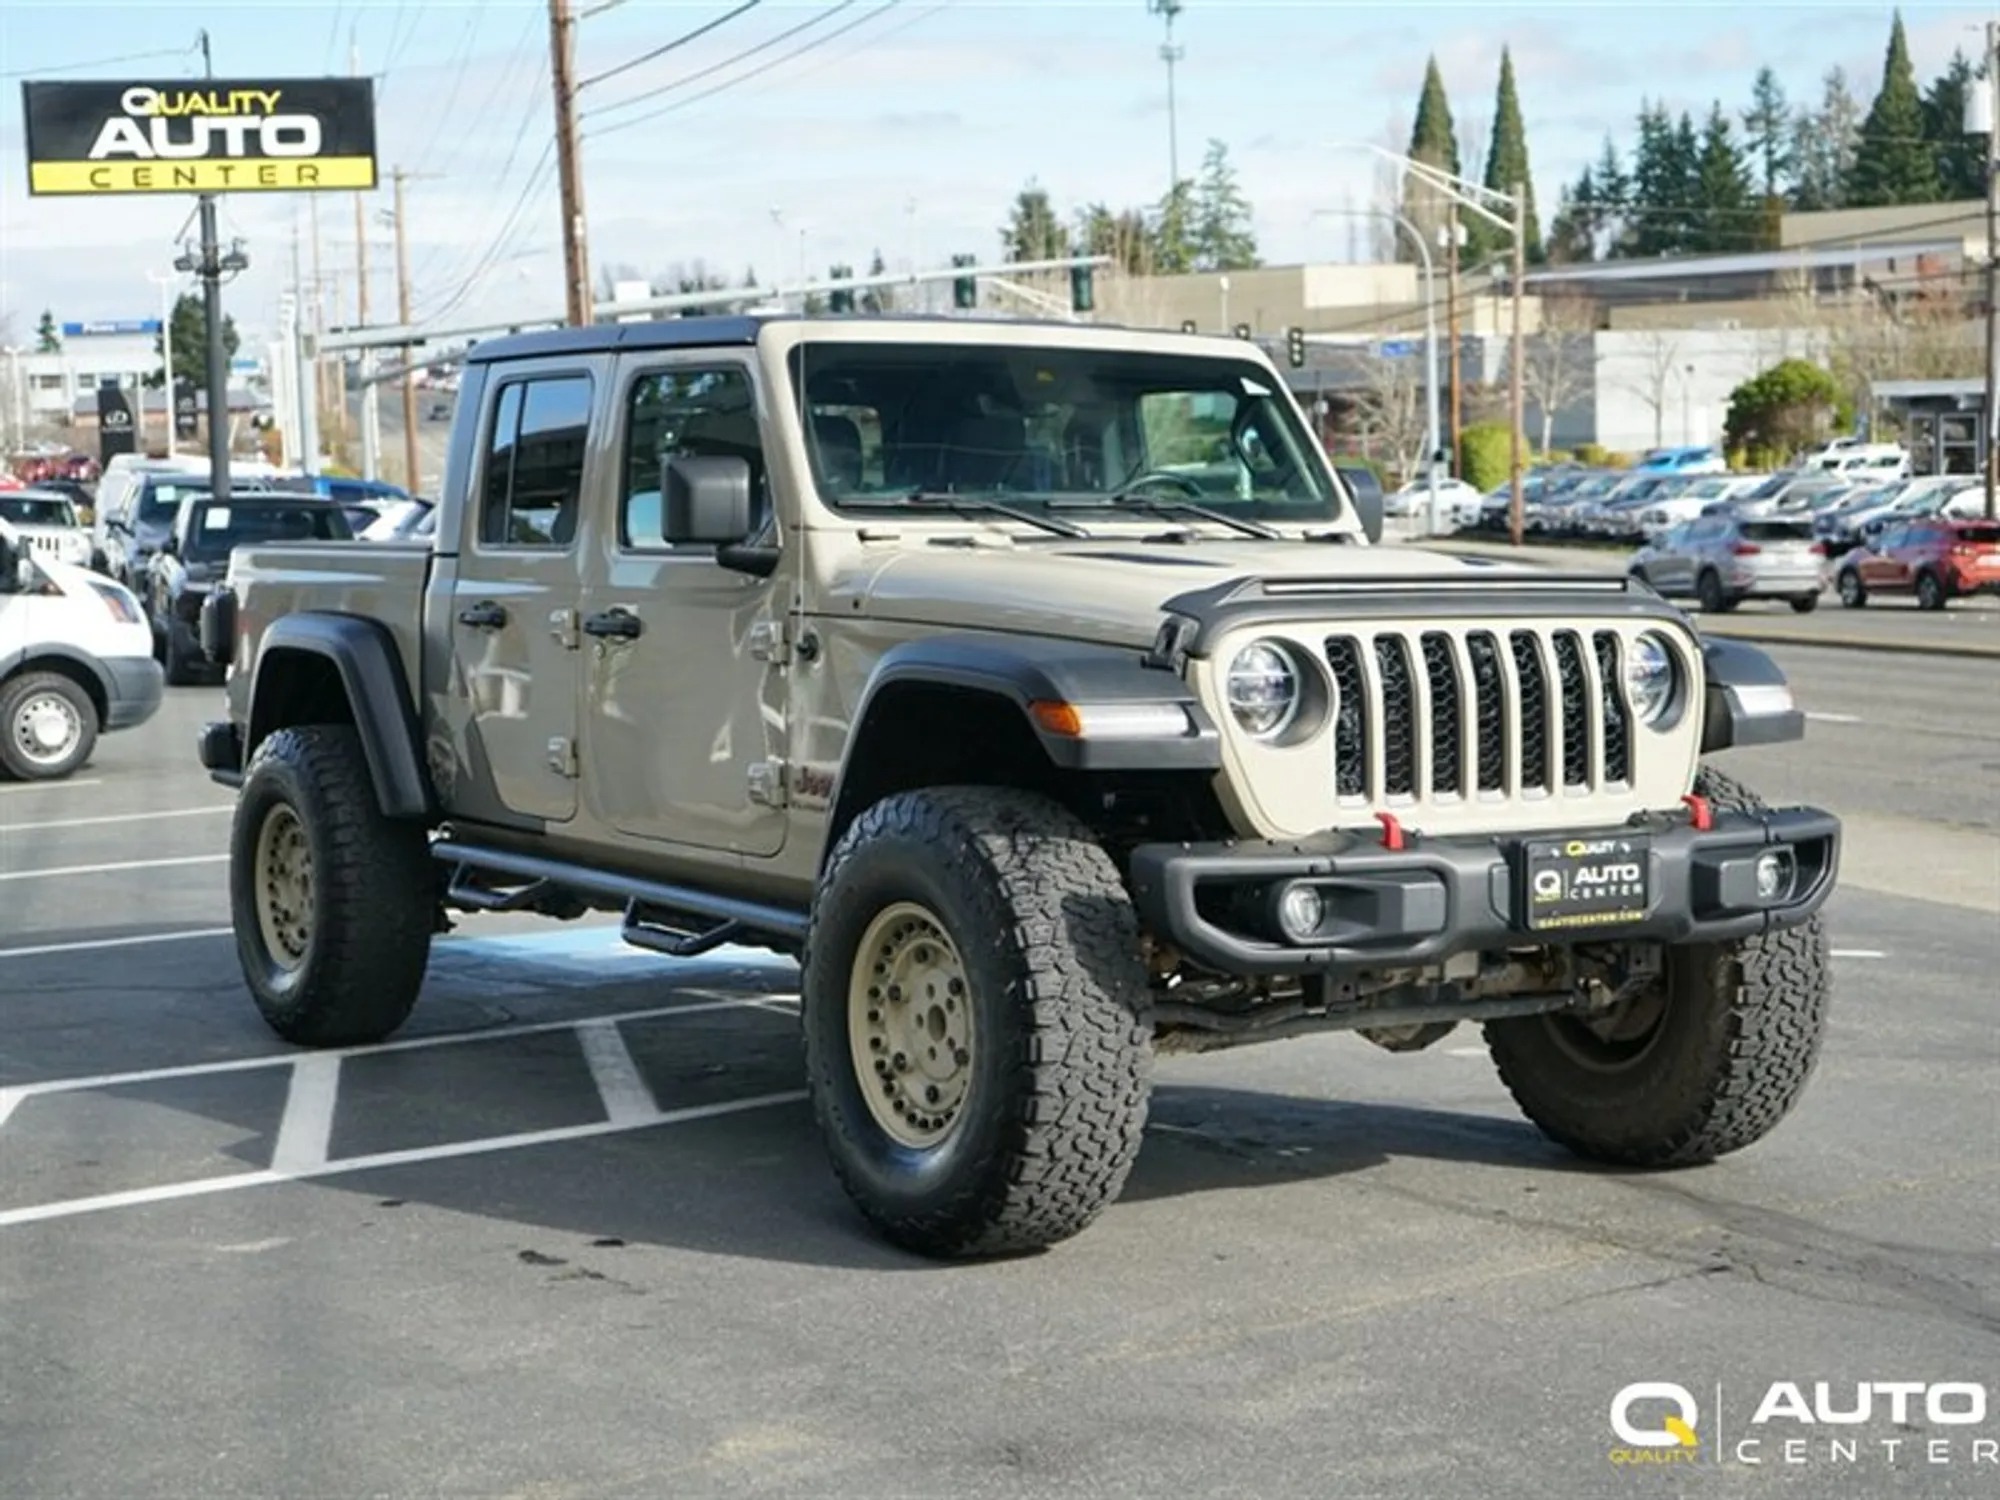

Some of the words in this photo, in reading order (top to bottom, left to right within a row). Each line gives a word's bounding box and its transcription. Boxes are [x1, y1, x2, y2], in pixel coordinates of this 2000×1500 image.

[121, 87, 282, 116] QUALITY
[88, 115, 321, 159] AUTO
[90, 165, 320, 188] CENTER
[1575, 864, 1640, 885] AUTO
[1570, 883, 1643, 900] CENTER
